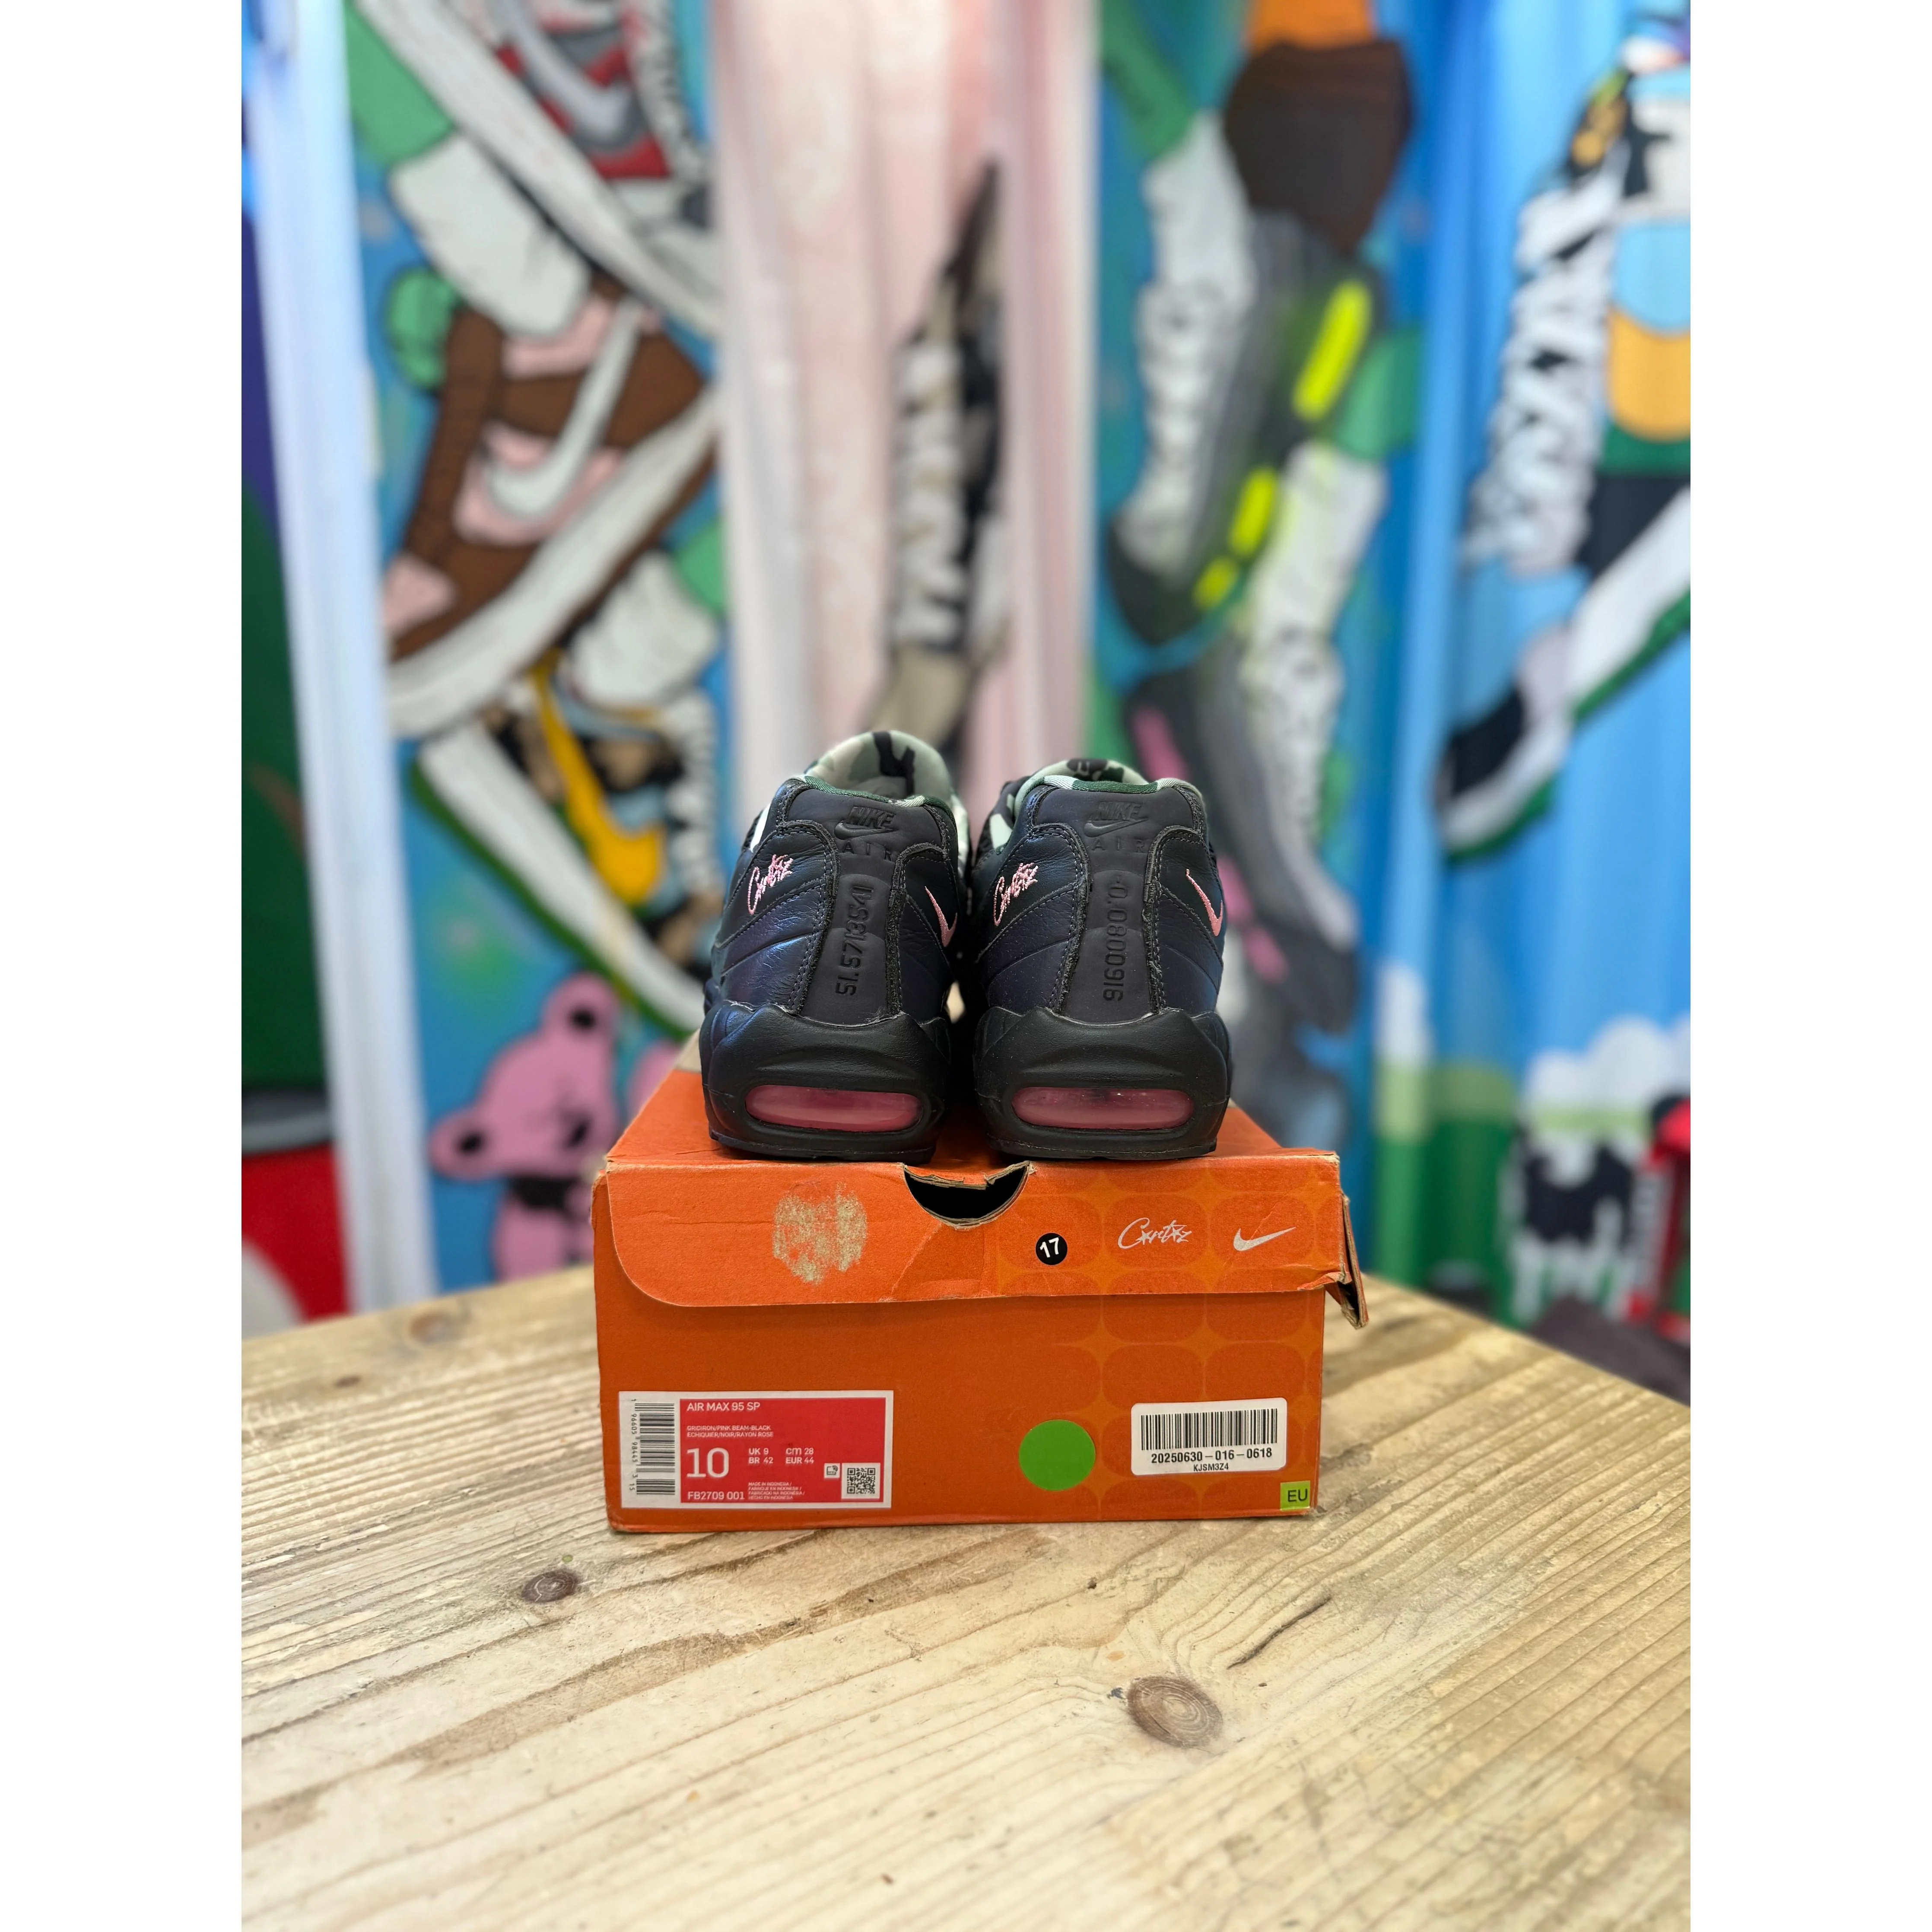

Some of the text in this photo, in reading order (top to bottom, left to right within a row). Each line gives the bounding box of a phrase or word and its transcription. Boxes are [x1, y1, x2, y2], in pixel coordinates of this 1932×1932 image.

[848, 805, 896, 828] NIKE
[1093, 801, 1143, 821] NIKE
[1091, 836, 1147, 853] AIR
[1039, 1236, 1060, 1258] 17
[686, 1402, 761, 1411] AIR MAX 95 SP
[686, 1447, 729, 1478] 10
[1193, 1463, 1229, 1472] KJSM3Z4
[687, 1491, 745, 1500] FB2709 001
[1287, 1488, 1308, 1503] EU
